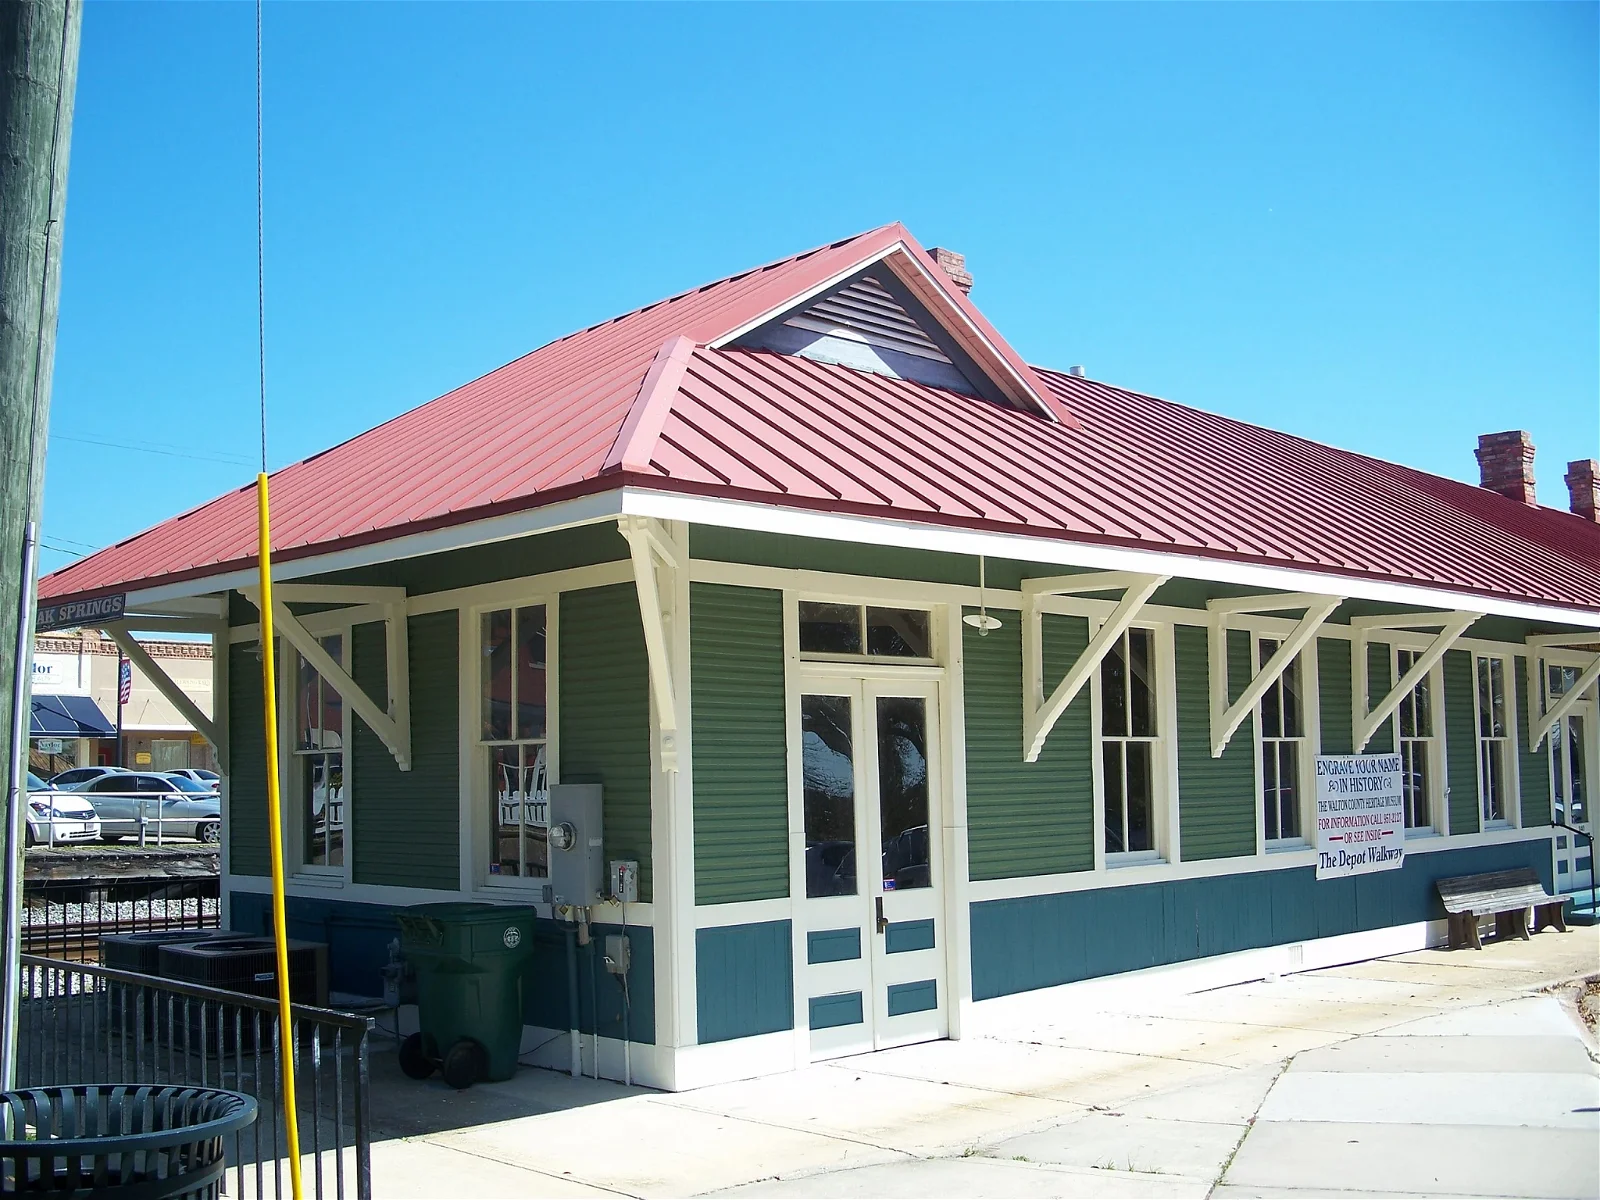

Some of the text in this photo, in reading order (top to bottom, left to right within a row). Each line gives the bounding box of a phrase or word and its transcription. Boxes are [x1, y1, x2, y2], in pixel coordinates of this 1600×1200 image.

[59, 596, 122, 621] SPRINGS
[1317, 757, 1400, 776] ENGRAVE YOUR NAME
[1340, 776, 1383, 793] IN HISTORY
[1318, 795, 1401, 812] THE WALTON COUNTY HERITAGE MUSEUM
[1318, 818, 1330, 830] FOR
[1330, 815, 1370, 829] INFORMATION
[1371, 813, 1383, 825] CALL
[1344, 829, 1382, 844] OR SEE INSIDE
[1319, 846, 1403, 871] The Depot Walkway
